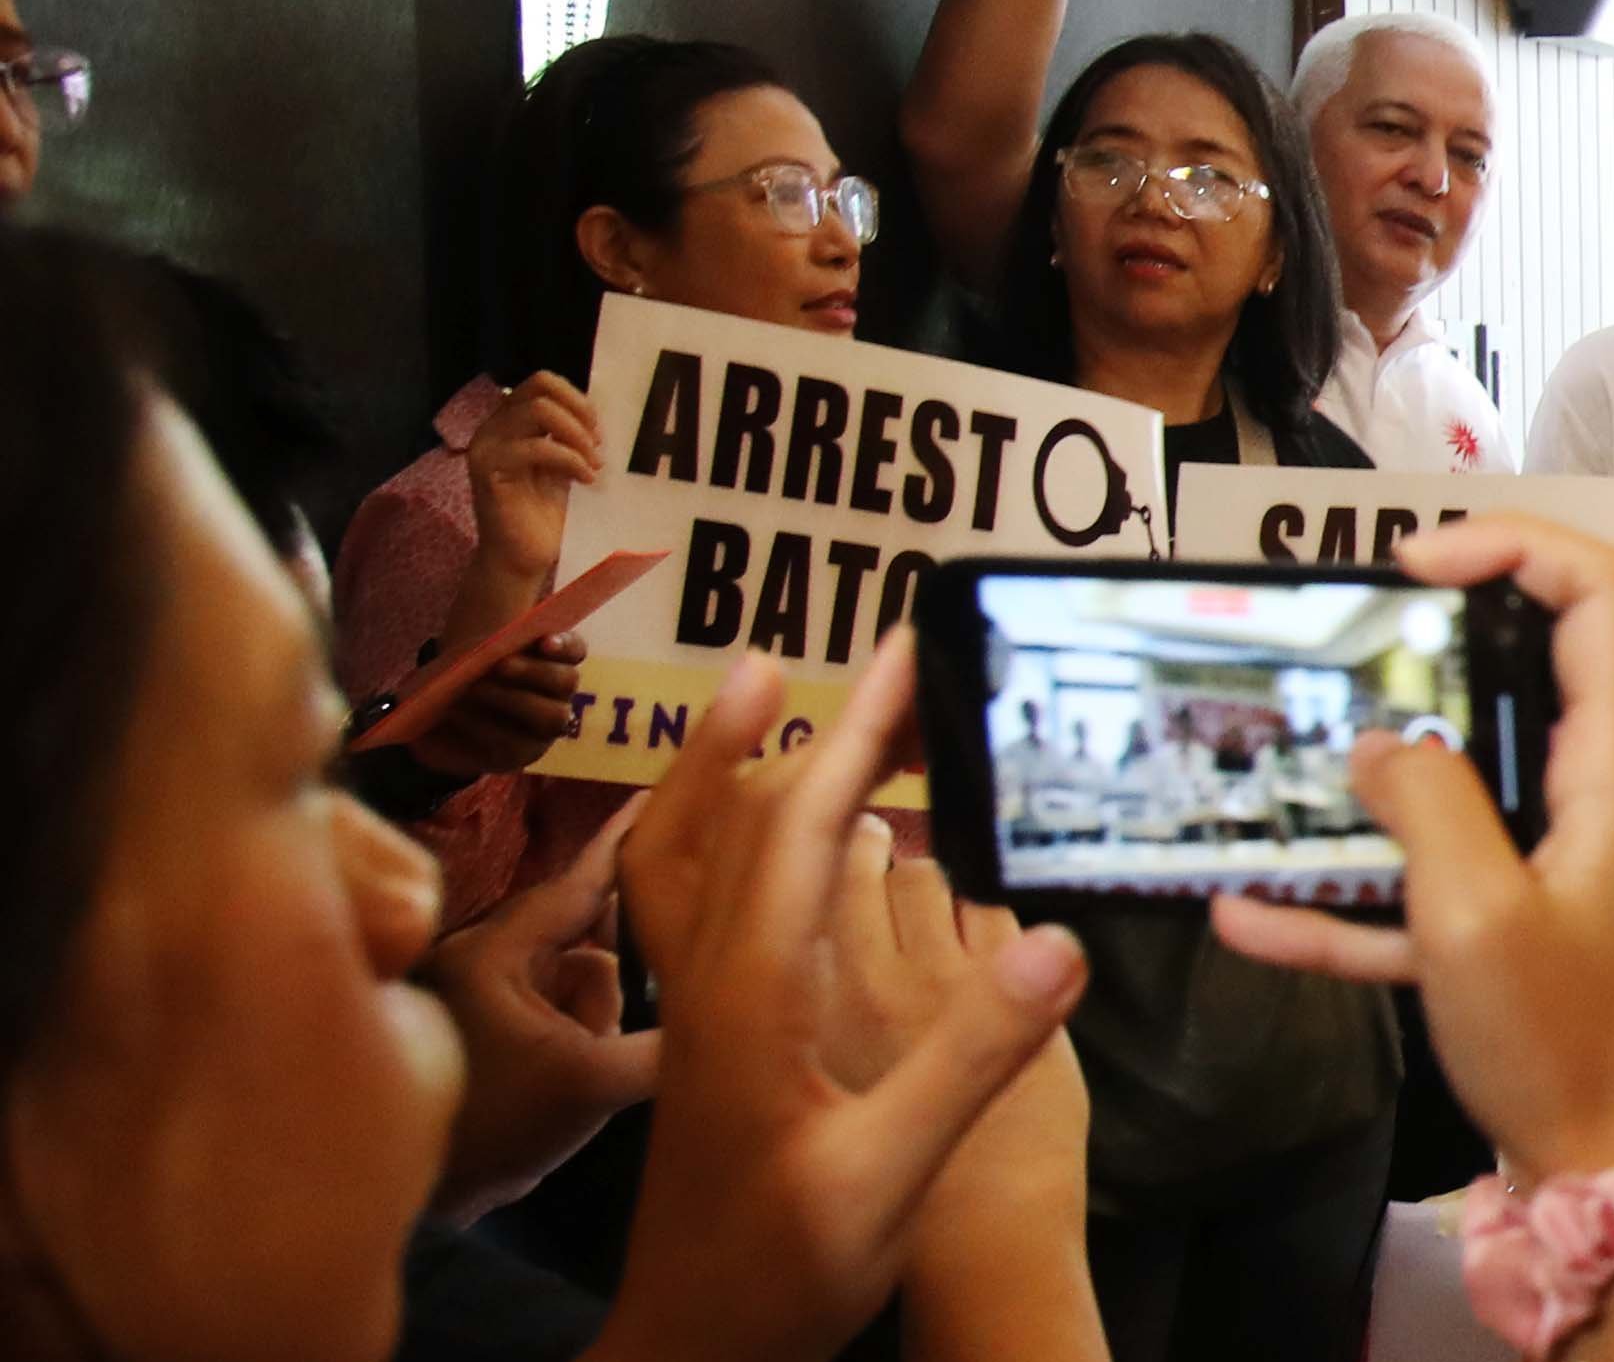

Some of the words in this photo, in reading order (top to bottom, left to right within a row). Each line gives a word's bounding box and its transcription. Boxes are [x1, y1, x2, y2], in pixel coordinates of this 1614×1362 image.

[628, 350, 1017, 532] ARREST
[1259, 503, 1469, 567] SAR
[572, 692, 814, 759] TING
